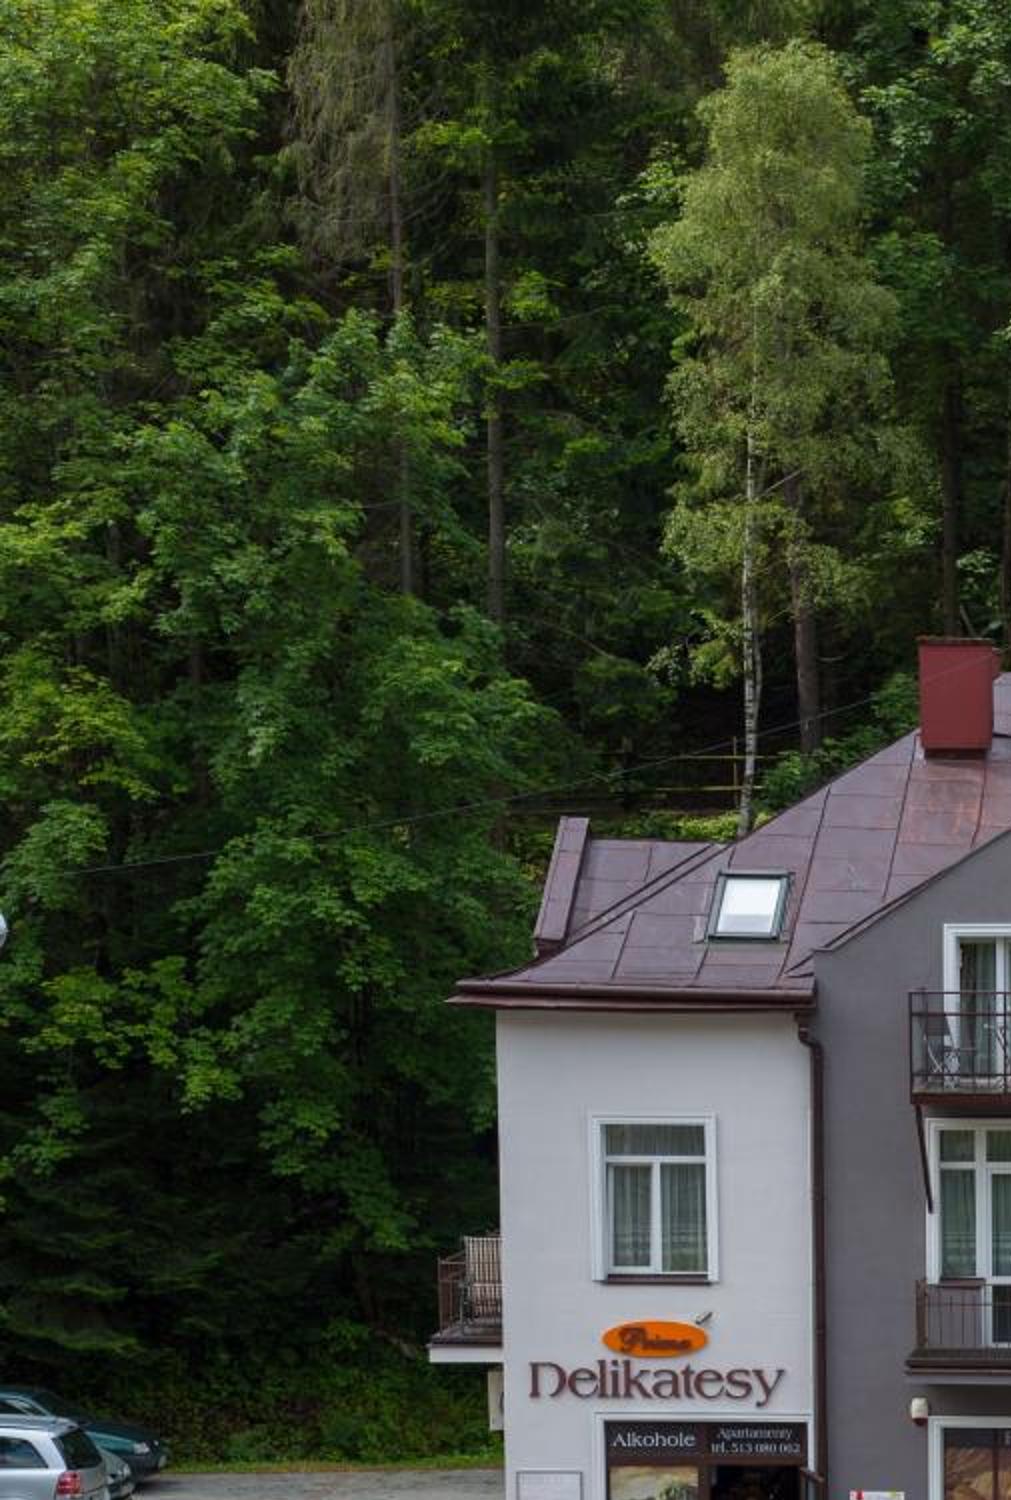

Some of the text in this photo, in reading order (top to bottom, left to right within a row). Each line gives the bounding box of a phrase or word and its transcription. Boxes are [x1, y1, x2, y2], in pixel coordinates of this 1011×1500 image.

[529, 1360, 785, 1407] Delikatesy
[612, 1432, 696, 1448] Alkohole
[717, 1427, 793, 1442] Apartamenty
